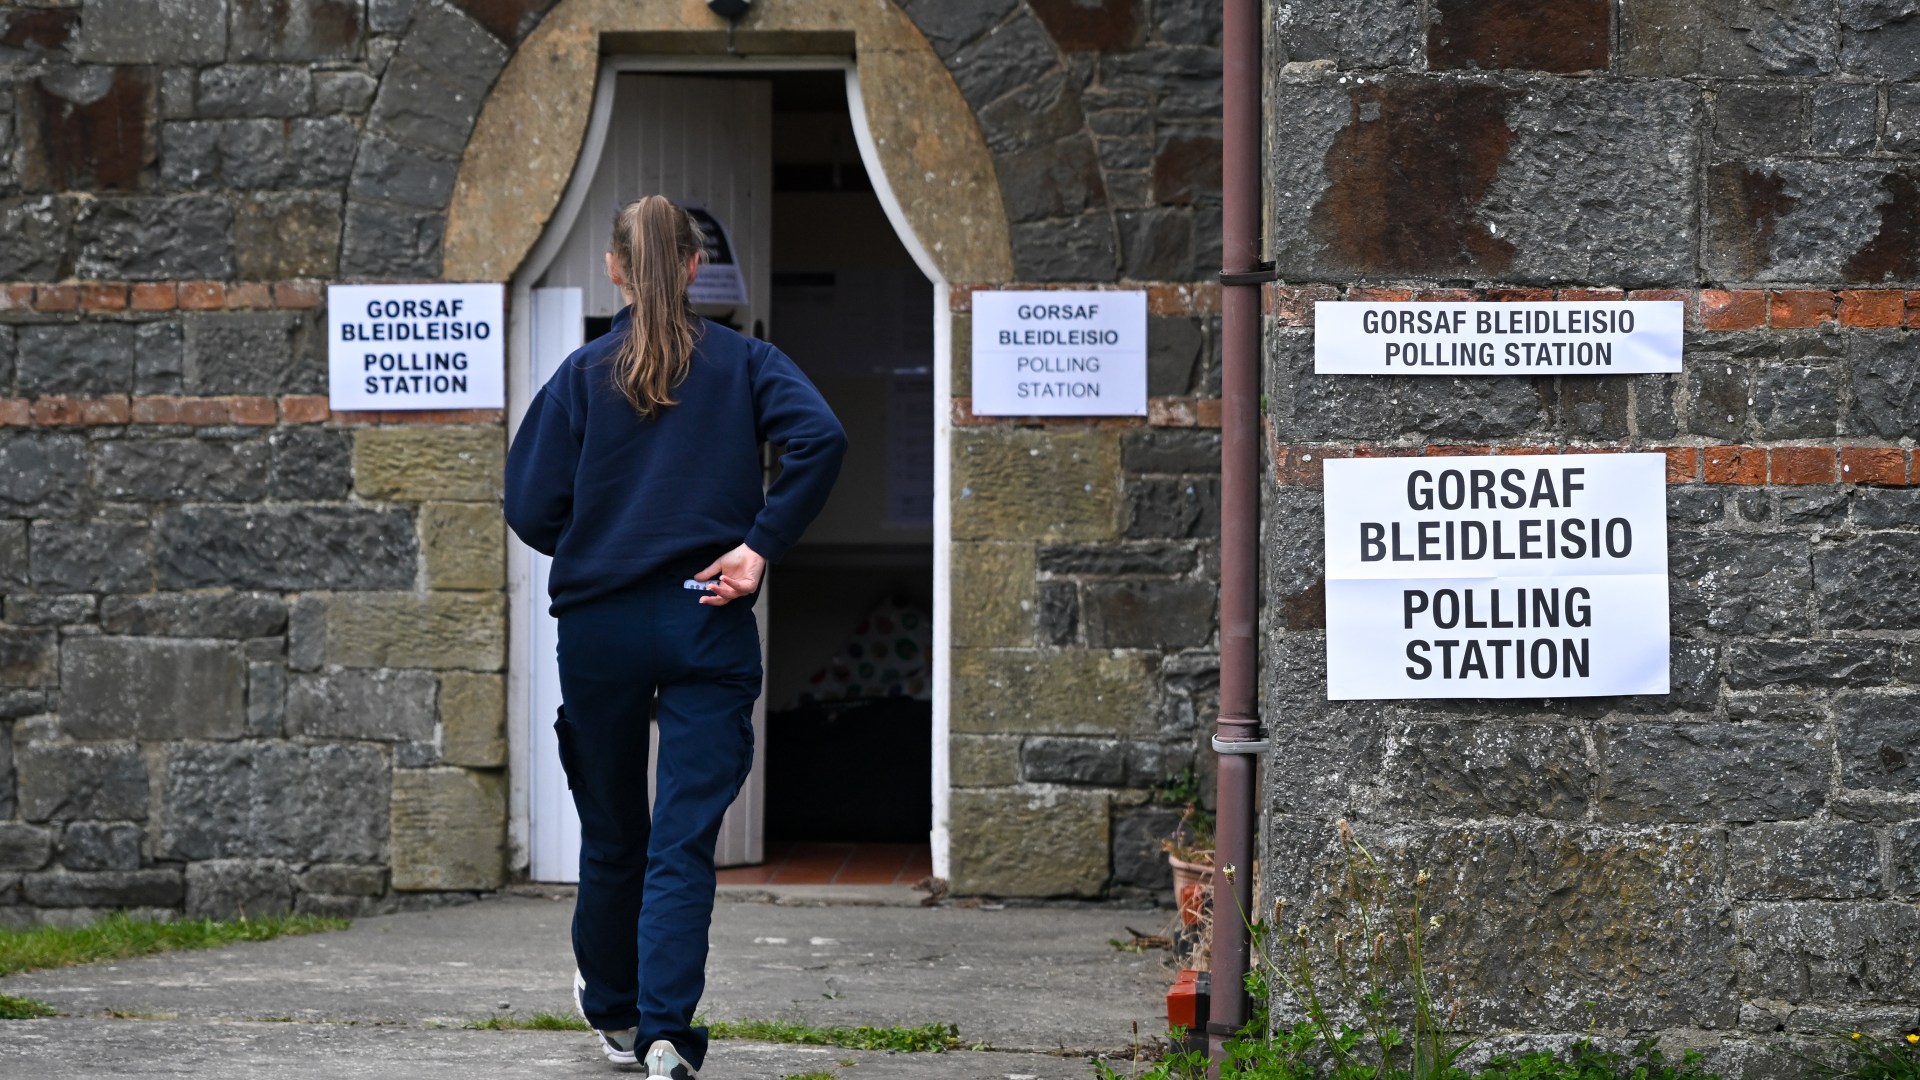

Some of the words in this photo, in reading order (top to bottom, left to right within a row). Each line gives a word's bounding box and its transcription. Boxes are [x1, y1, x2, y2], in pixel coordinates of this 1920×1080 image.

[367, 300, 463, 318] GORSAF
[1018, 304, 1099, 321] GORSAF
[342, 322, 490, 341] BLEIDLEISIO
[1363, 310, 1467, 334] GORSAF
[1476, 310, 1635, 334] BLEIDLEISIO
[999, 329, 1119, 346] BLEIDLEISIO
[365, 352, 467, 371] POLLING
[1385, 342, 1495, 366] POLLING
[1504, 342, 1612, 366] STATION
[1017, 356, 1101, 373] POLLING
[366, 375, 467, 394] STATION
[1017, 382, 1101, 398] STATION
[1407, 468, 1585, 511] GORSAF
[1360, 517, 1633, 562] BLEIDLEISIO
[1403, 587, 1592, 630] POLLING
[1405, 638, 1590, 681] STATION
